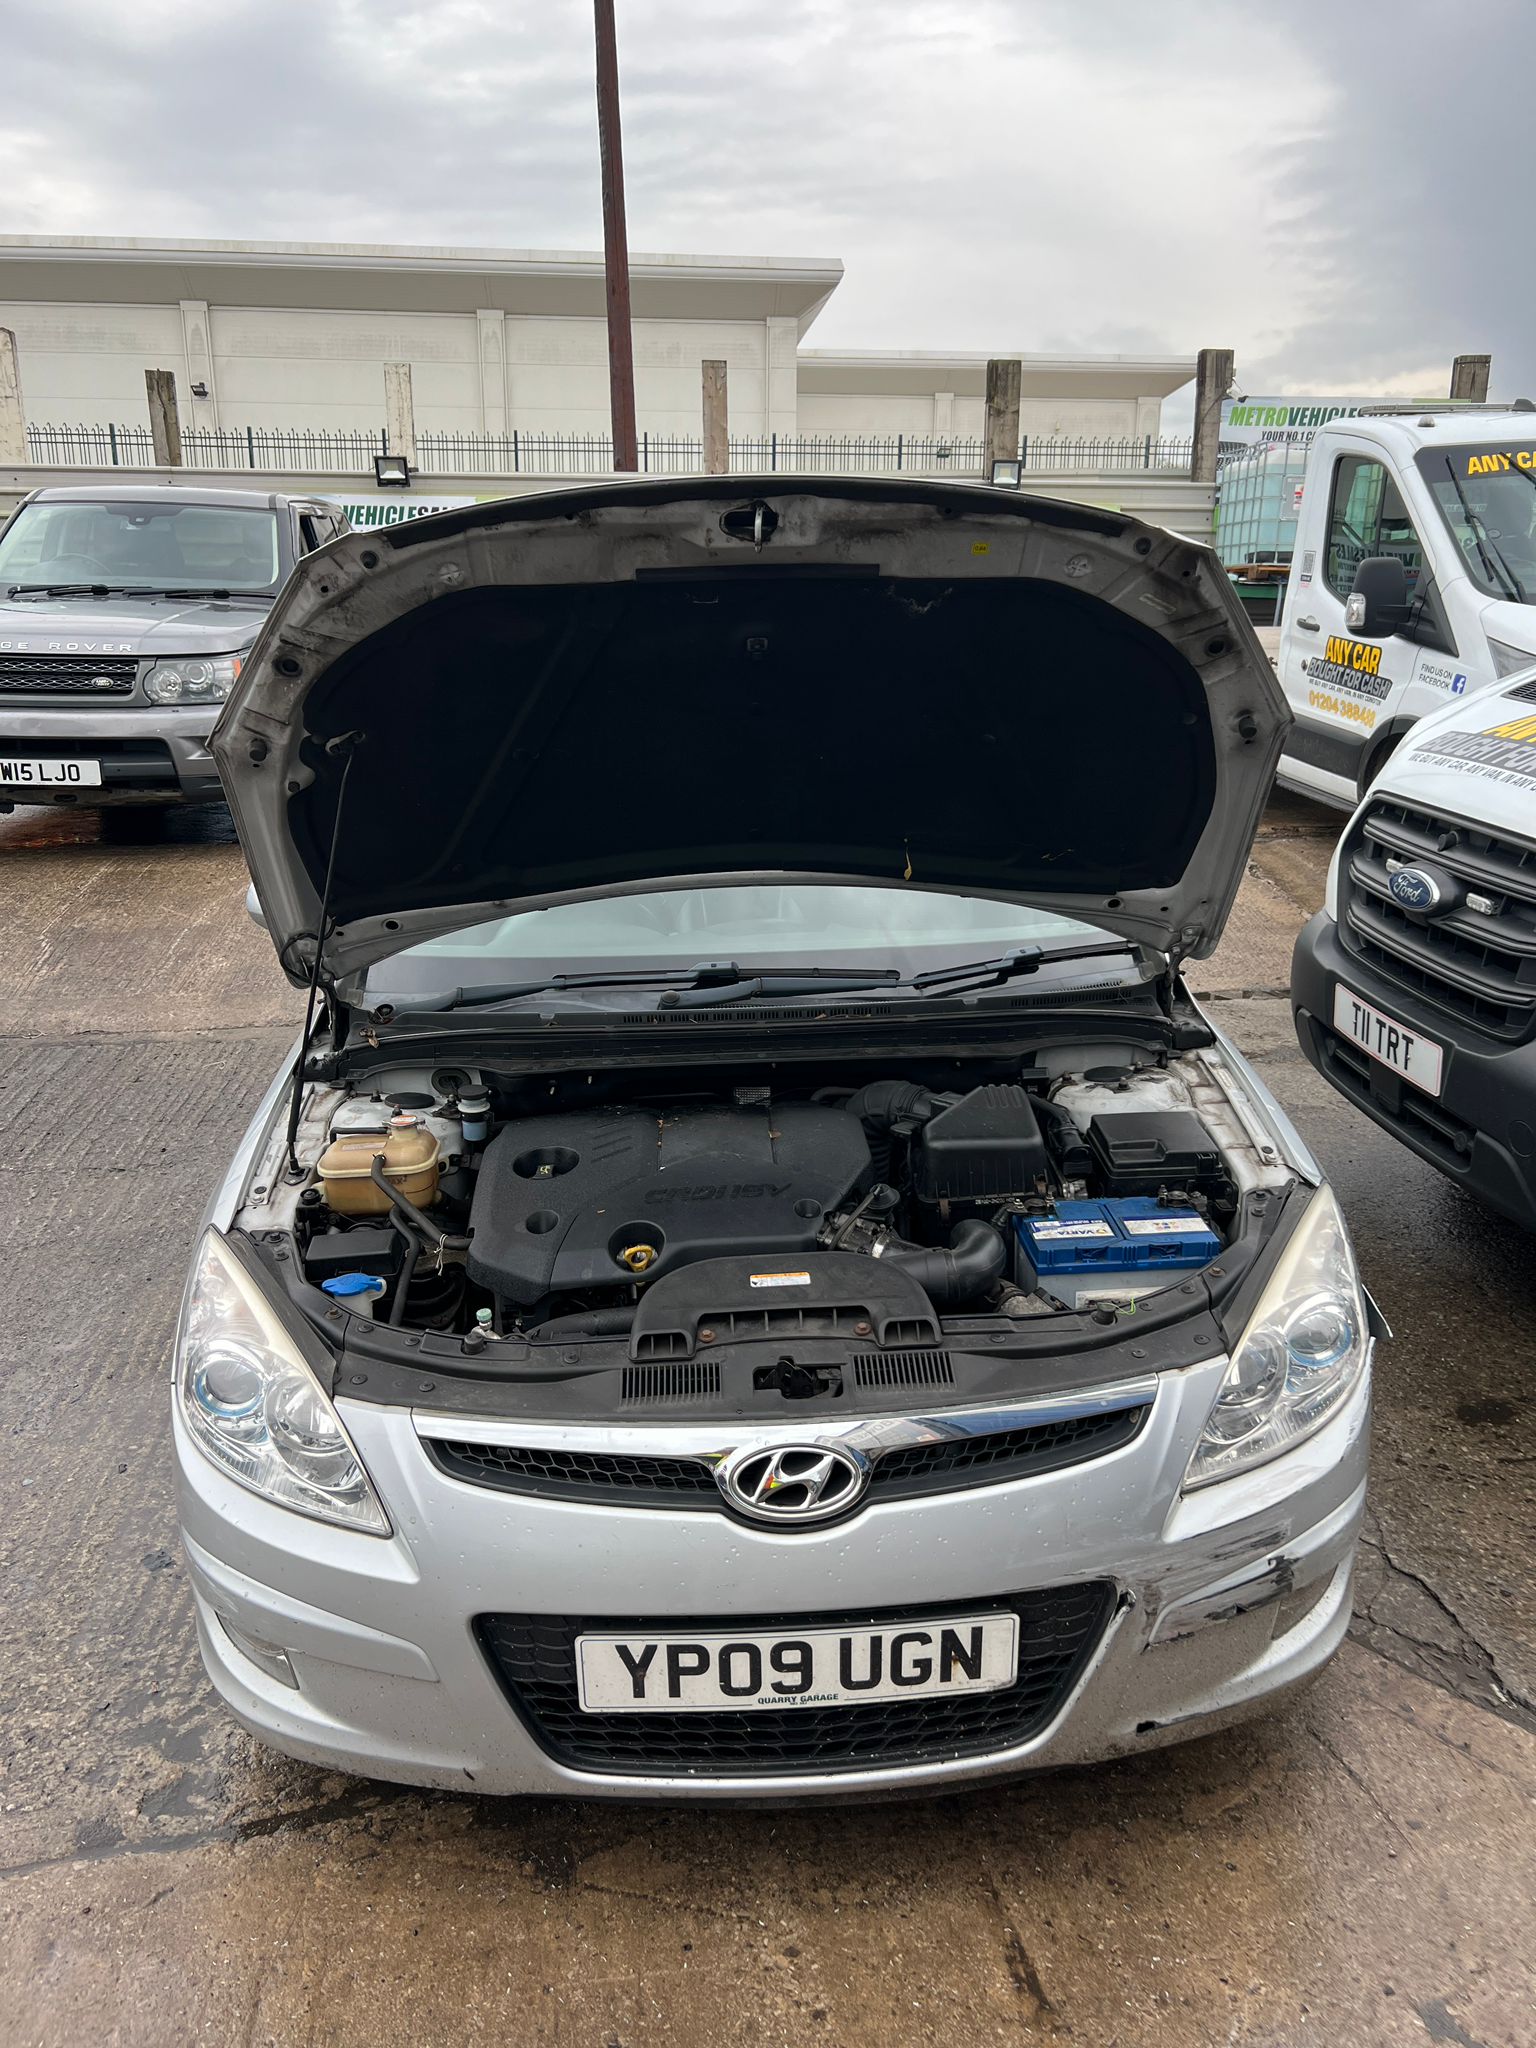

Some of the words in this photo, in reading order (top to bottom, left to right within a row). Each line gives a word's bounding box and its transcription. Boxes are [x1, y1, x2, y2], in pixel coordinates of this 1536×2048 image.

[1261, 431, 1284, 441] YOUR
[1467, 452, 1512, 475] ANY
[48, 642, 132, 652] ROVER
[1325, 637, 1353, 666] ANY
[1352, 643, 1382, 675] CAR
[1308, 659, 1344, 681] BOUGHT
[1342, 667, 1362, 690] FOR
[1420, 663, 1436, 674] FIND
[1443, 669, 1453, 679] ON
[1419, 674, 1450, 690] FACEBOOK
[1309, 690, 1339, 716] 01204
[1418, 732, 1520, 761] BOUGHT
[39, 764, 80, 782] LJO
[1431, 757, 1450, 768] ANY
[1464, 763, 1487, 775] ANY
[1393, 874, 1422, 903] Ford
[1375, 1018, 1415, 1071] TRT
[1056, 1228, 1094, 1236] VARTA
[614, 1641, 815, 1699] YP09
[838, 1625, 984, 1691] UGN
[757, 1696, 797, 1705] QUARRY
[800, 1693, 839, 1703] GARAGE
